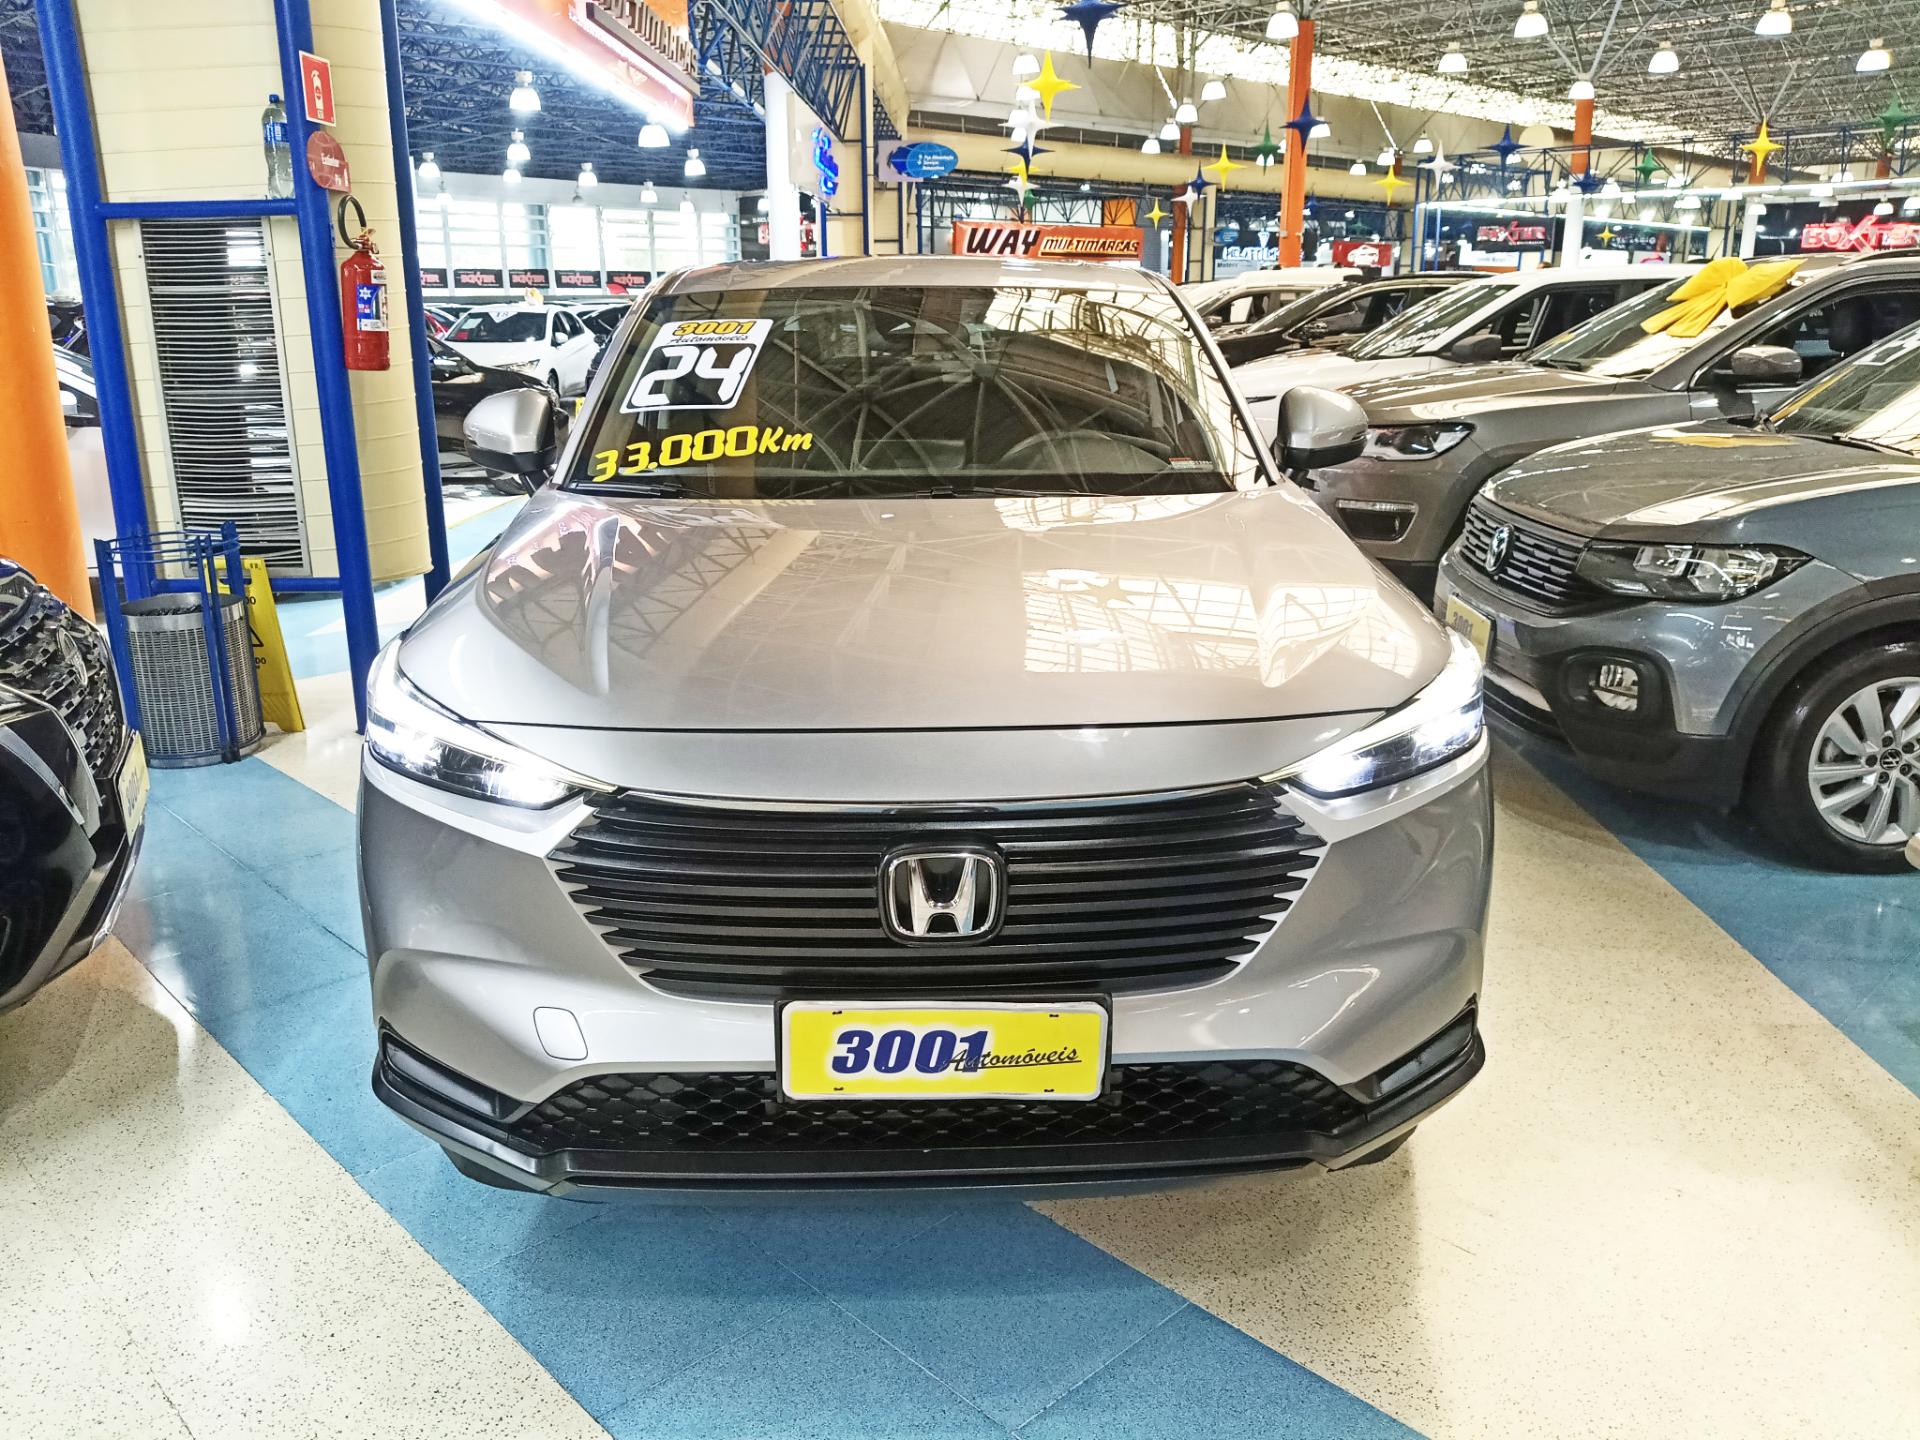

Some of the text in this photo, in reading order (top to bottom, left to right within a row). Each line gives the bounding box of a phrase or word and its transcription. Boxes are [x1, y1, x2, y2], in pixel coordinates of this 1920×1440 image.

[965, 227, 1140, 255] WAY MULTIMARCAS
[672, 320, 757, 336] 3001
[630, 345, 753, 407] 24
[831, 1029, 989, 1075] 3001
[942, 1045, 1082, 1073] Automóveis
